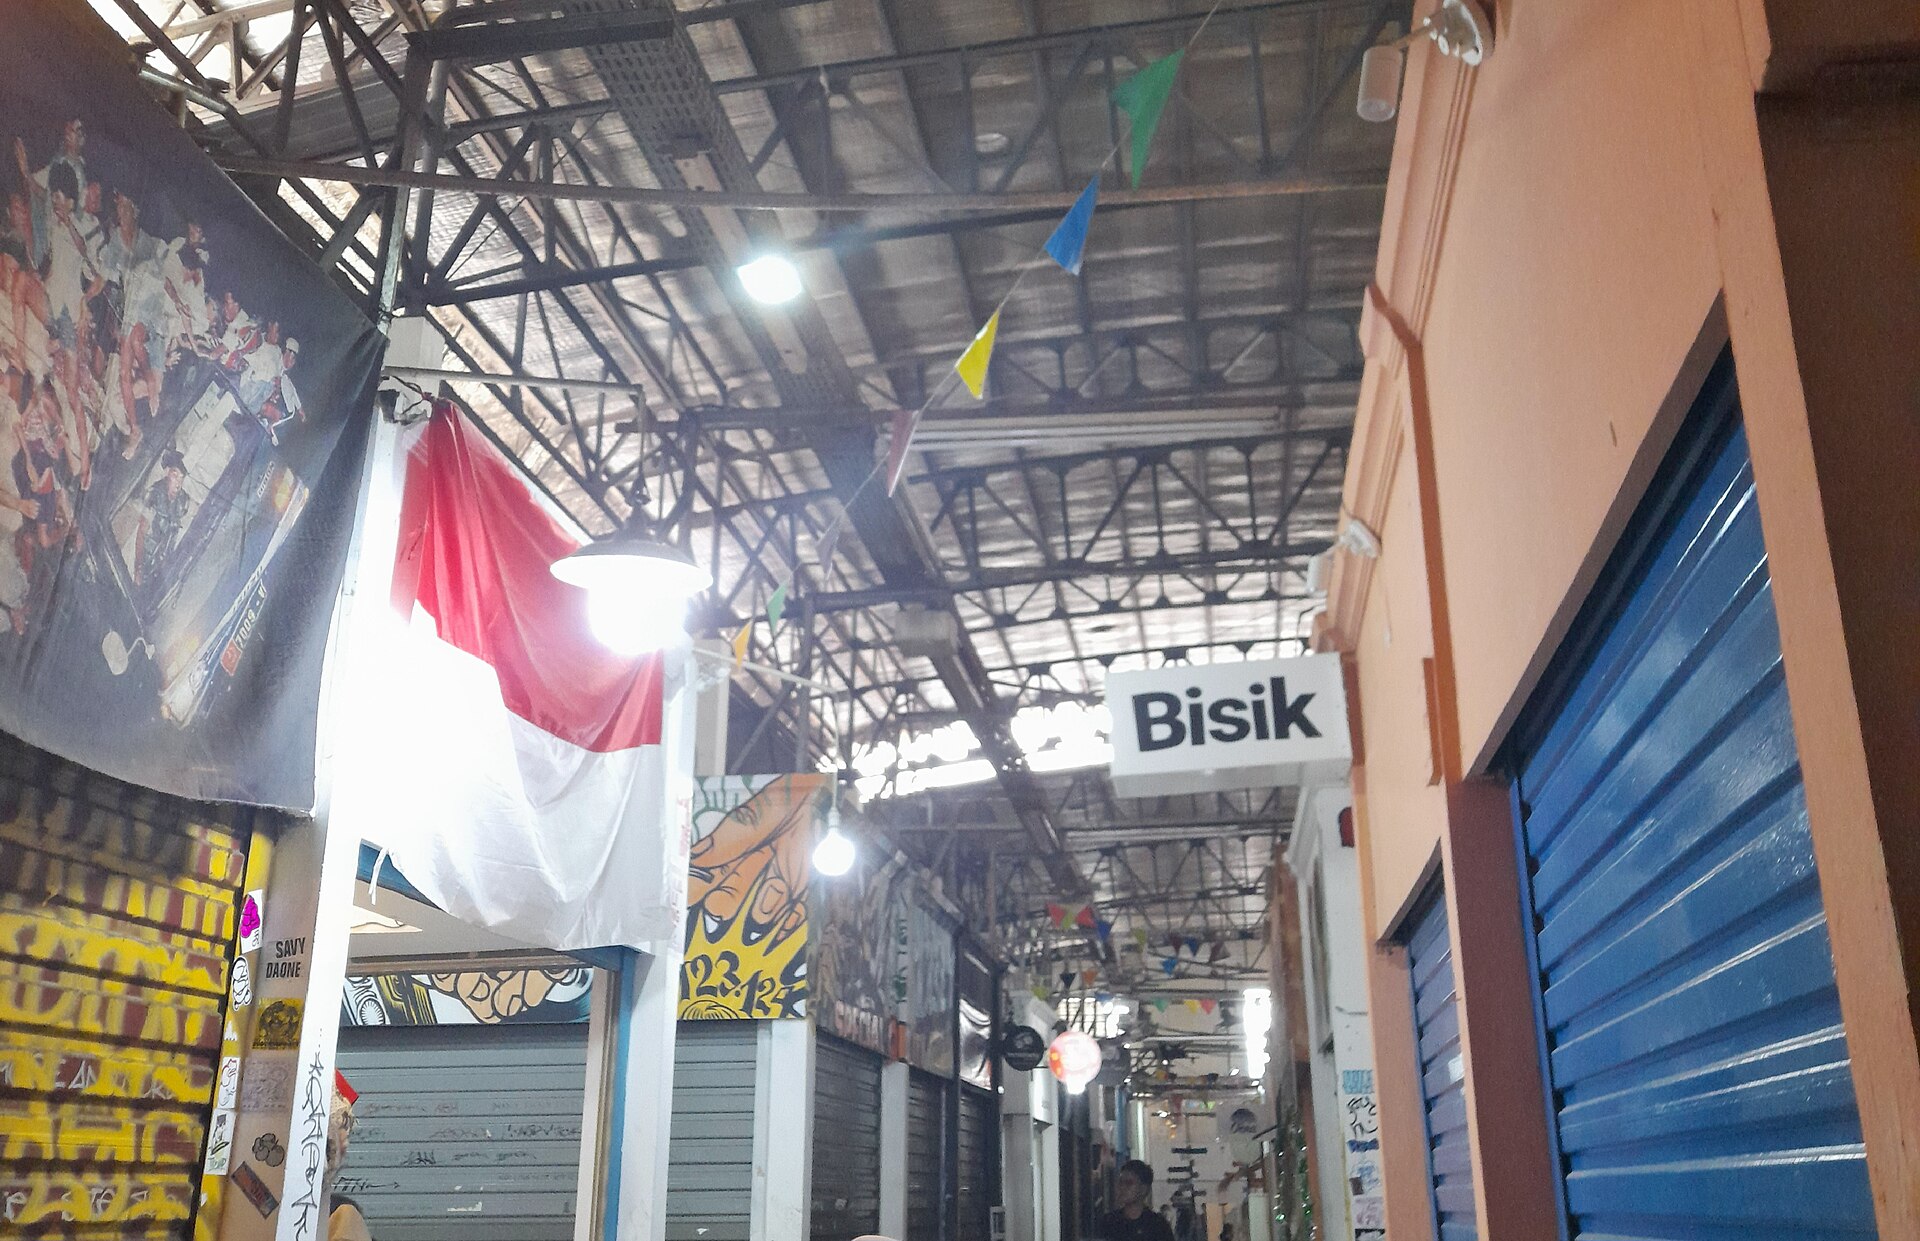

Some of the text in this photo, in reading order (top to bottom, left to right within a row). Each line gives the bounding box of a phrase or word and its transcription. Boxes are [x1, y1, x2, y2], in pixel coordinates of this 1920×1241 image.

[1132, 676, 1323, 752] Bisik
[276, 937, 306, 959] SAVY
[265, 961, 301, 979] DAONE
